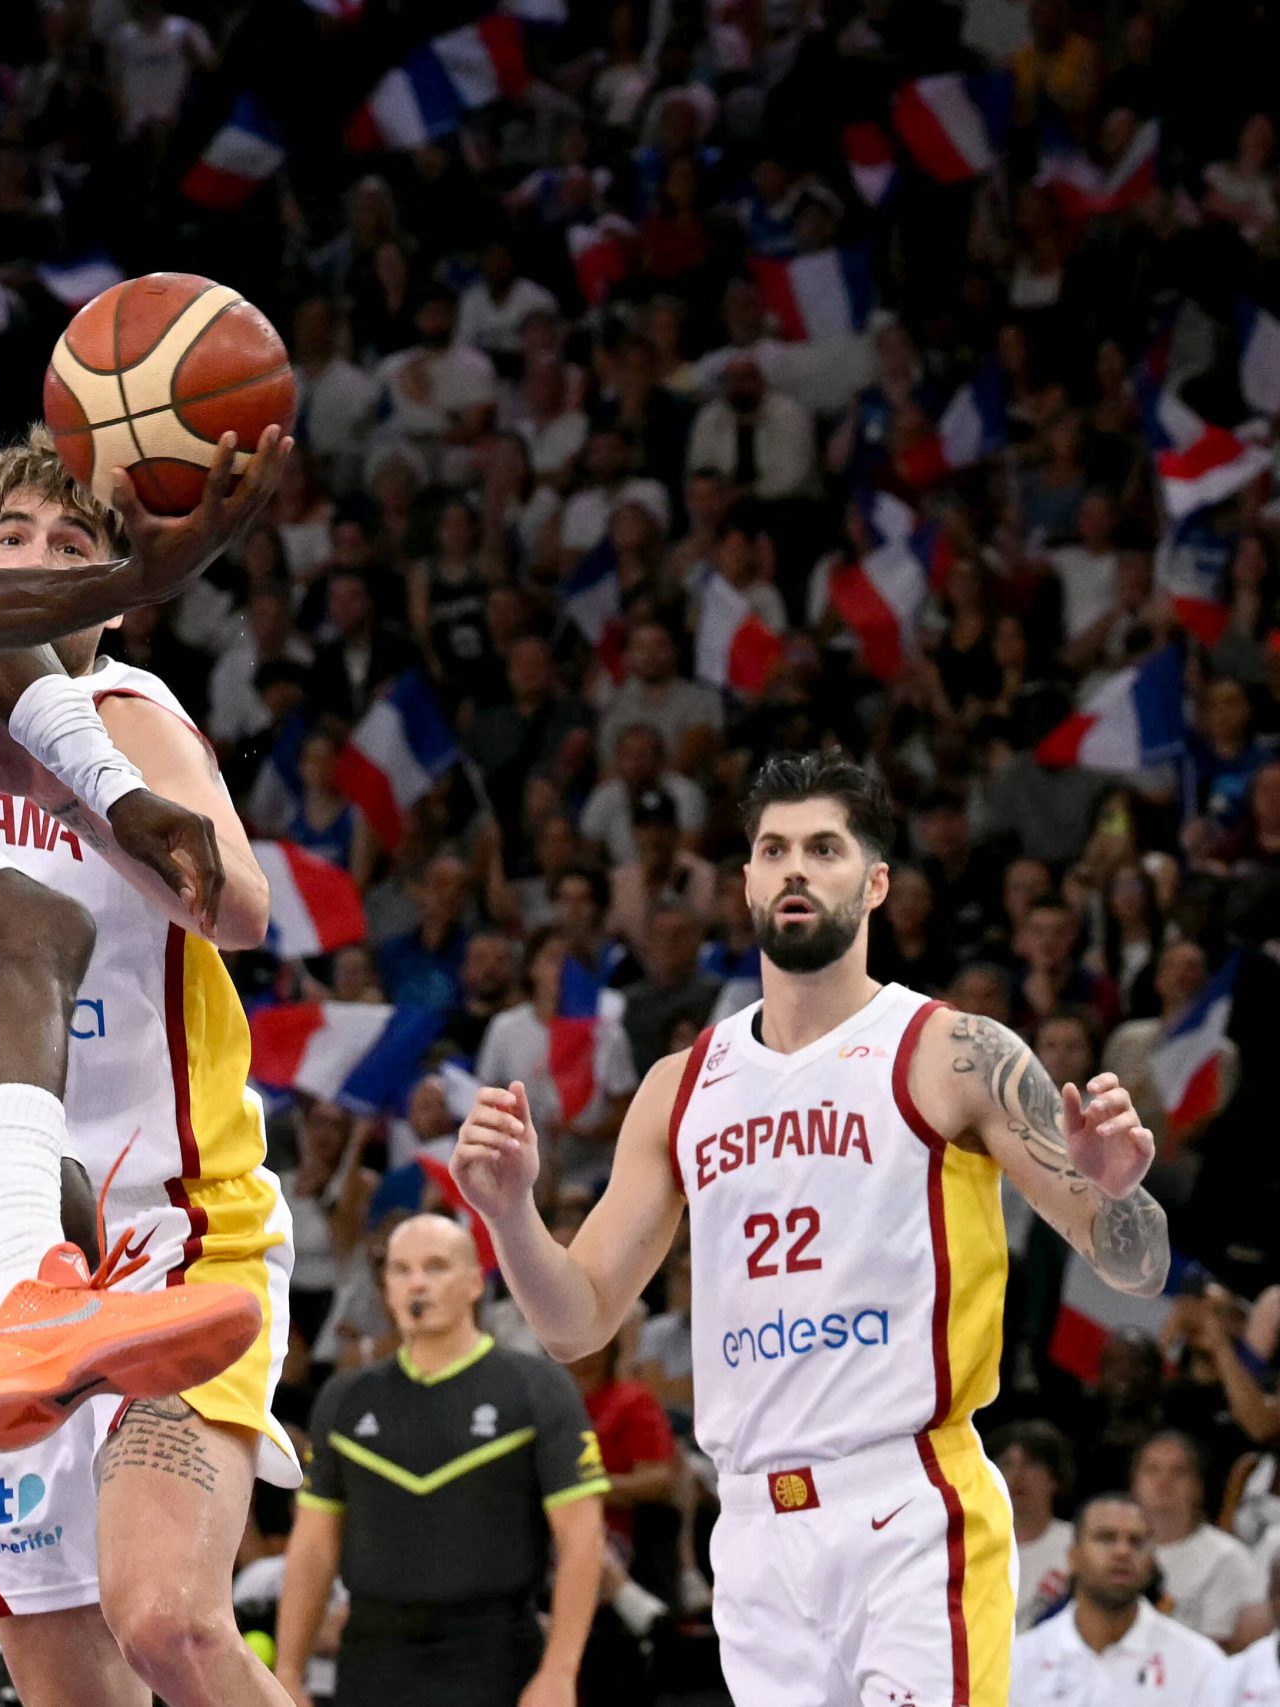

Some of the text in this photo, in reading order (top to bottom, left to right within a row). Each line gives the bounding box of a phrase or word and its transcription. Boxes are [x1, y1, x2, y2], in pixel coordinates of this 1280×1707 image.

[695, 1100, 874, 1191] ESPAÑA
[743, 1205, 823, 1280] 22
[722, 1308, 889, 1368] endesa
